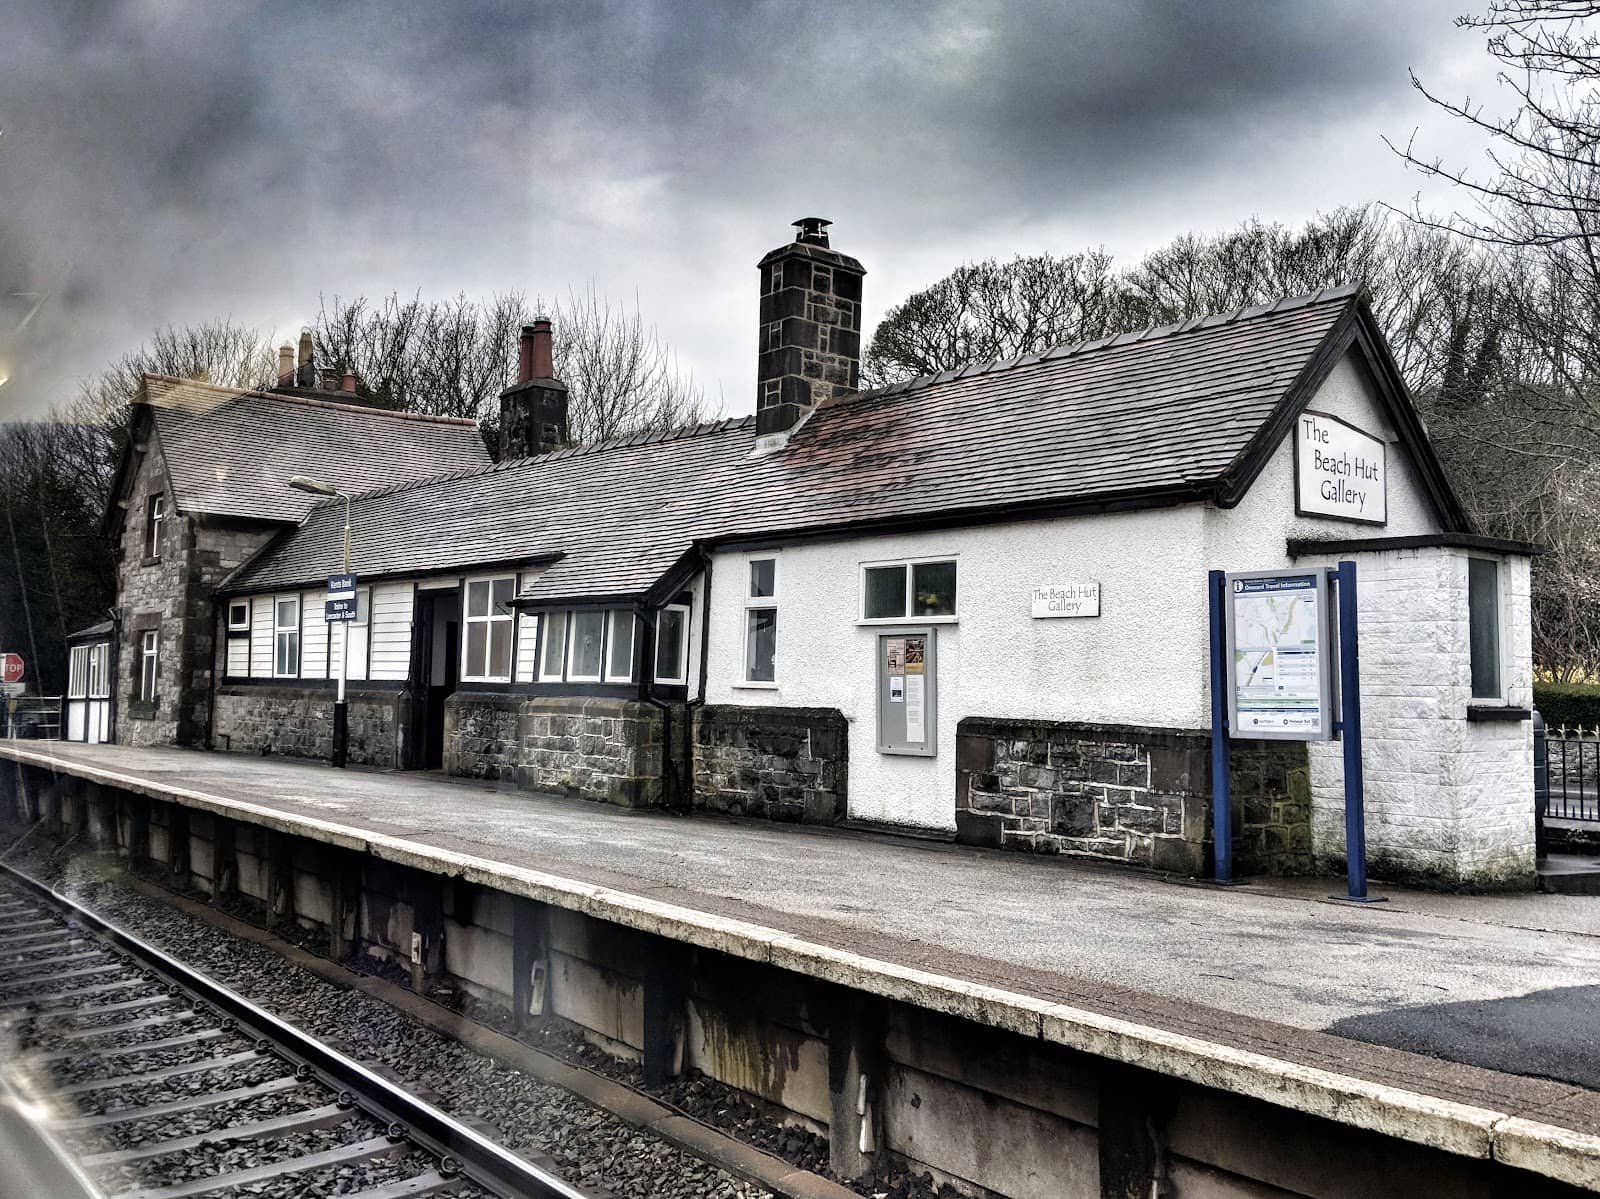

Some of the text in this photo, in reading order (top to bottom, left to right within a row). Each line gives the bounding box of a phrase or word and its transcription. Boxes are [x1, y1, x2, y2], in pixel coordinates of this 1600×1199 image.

[1303, 417, 1330, 444] The
[1314, 448, 1379, 482] Beach Hut
[1320, 479, 1366, 513] Gallery
[1280, 580, 1311, 589] Information
[1033, 586, 1097, 600] The Beach Hut
[1048, 600, 1082, 615] Gallery
[5, 663, 22, 673] TOP
